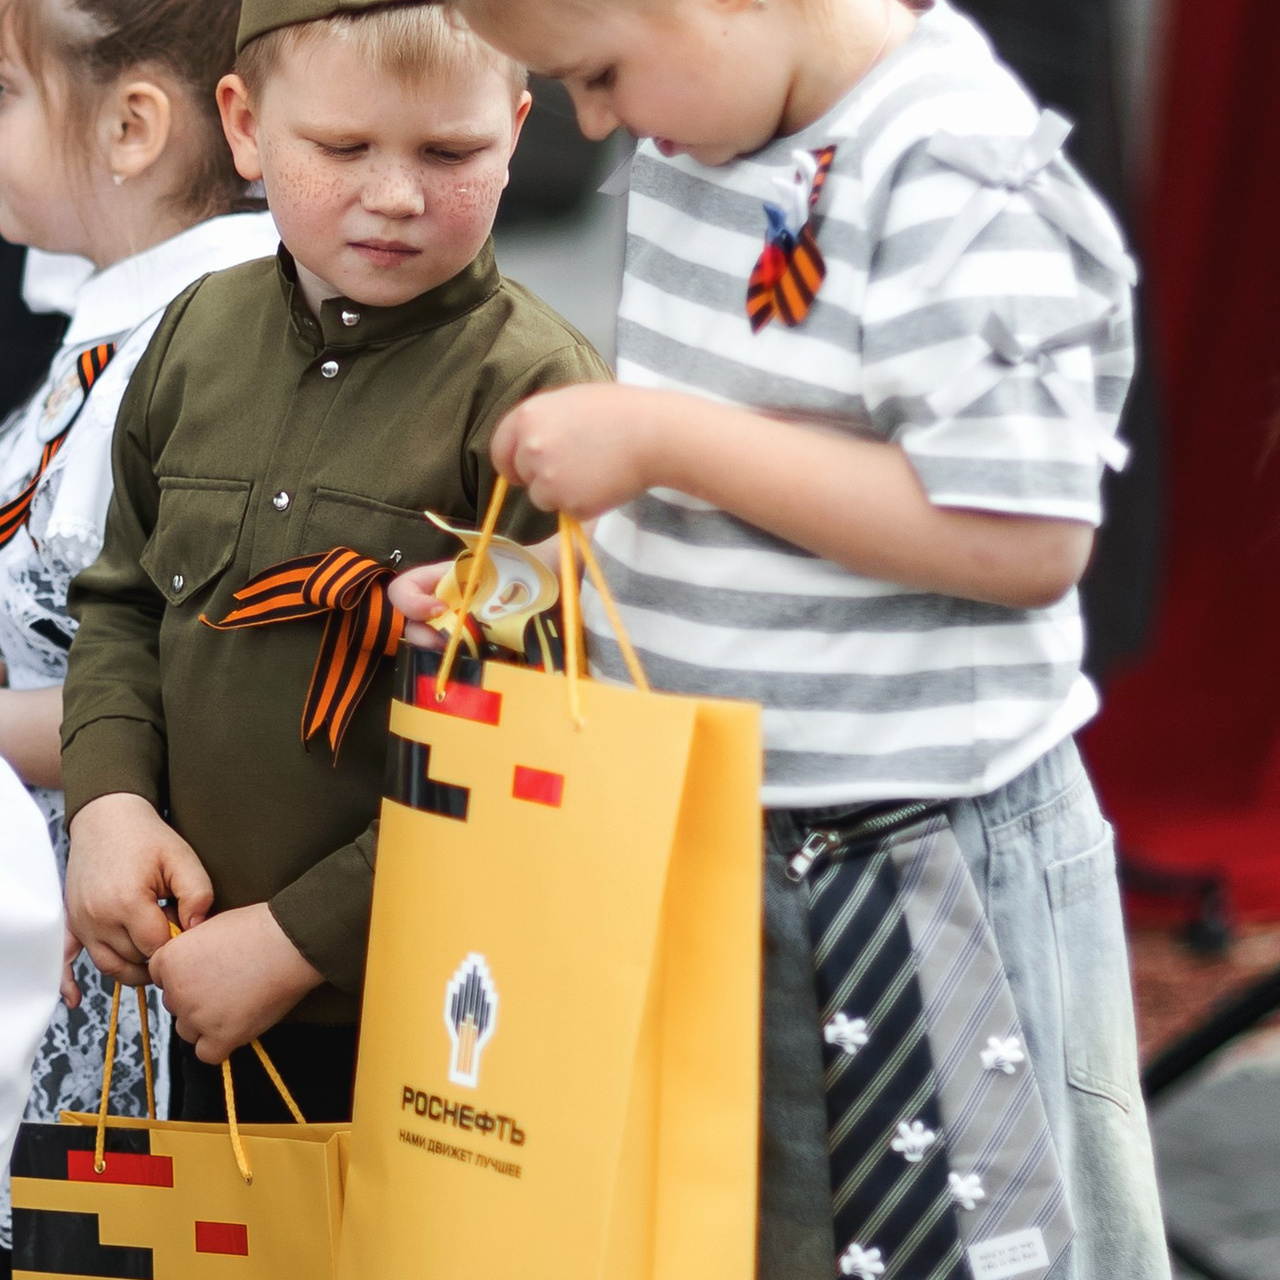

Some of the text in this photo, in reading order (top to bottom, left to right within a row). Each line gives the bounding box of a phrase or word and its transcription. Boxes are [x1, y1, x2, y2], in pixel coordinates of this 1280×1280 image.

[401, 1086, 525, 1147] РОСНЕФТЬ
[399, 1129, 522, 1179] НАМИ ДВИЖЕТ ЛУЧШЕЕ
